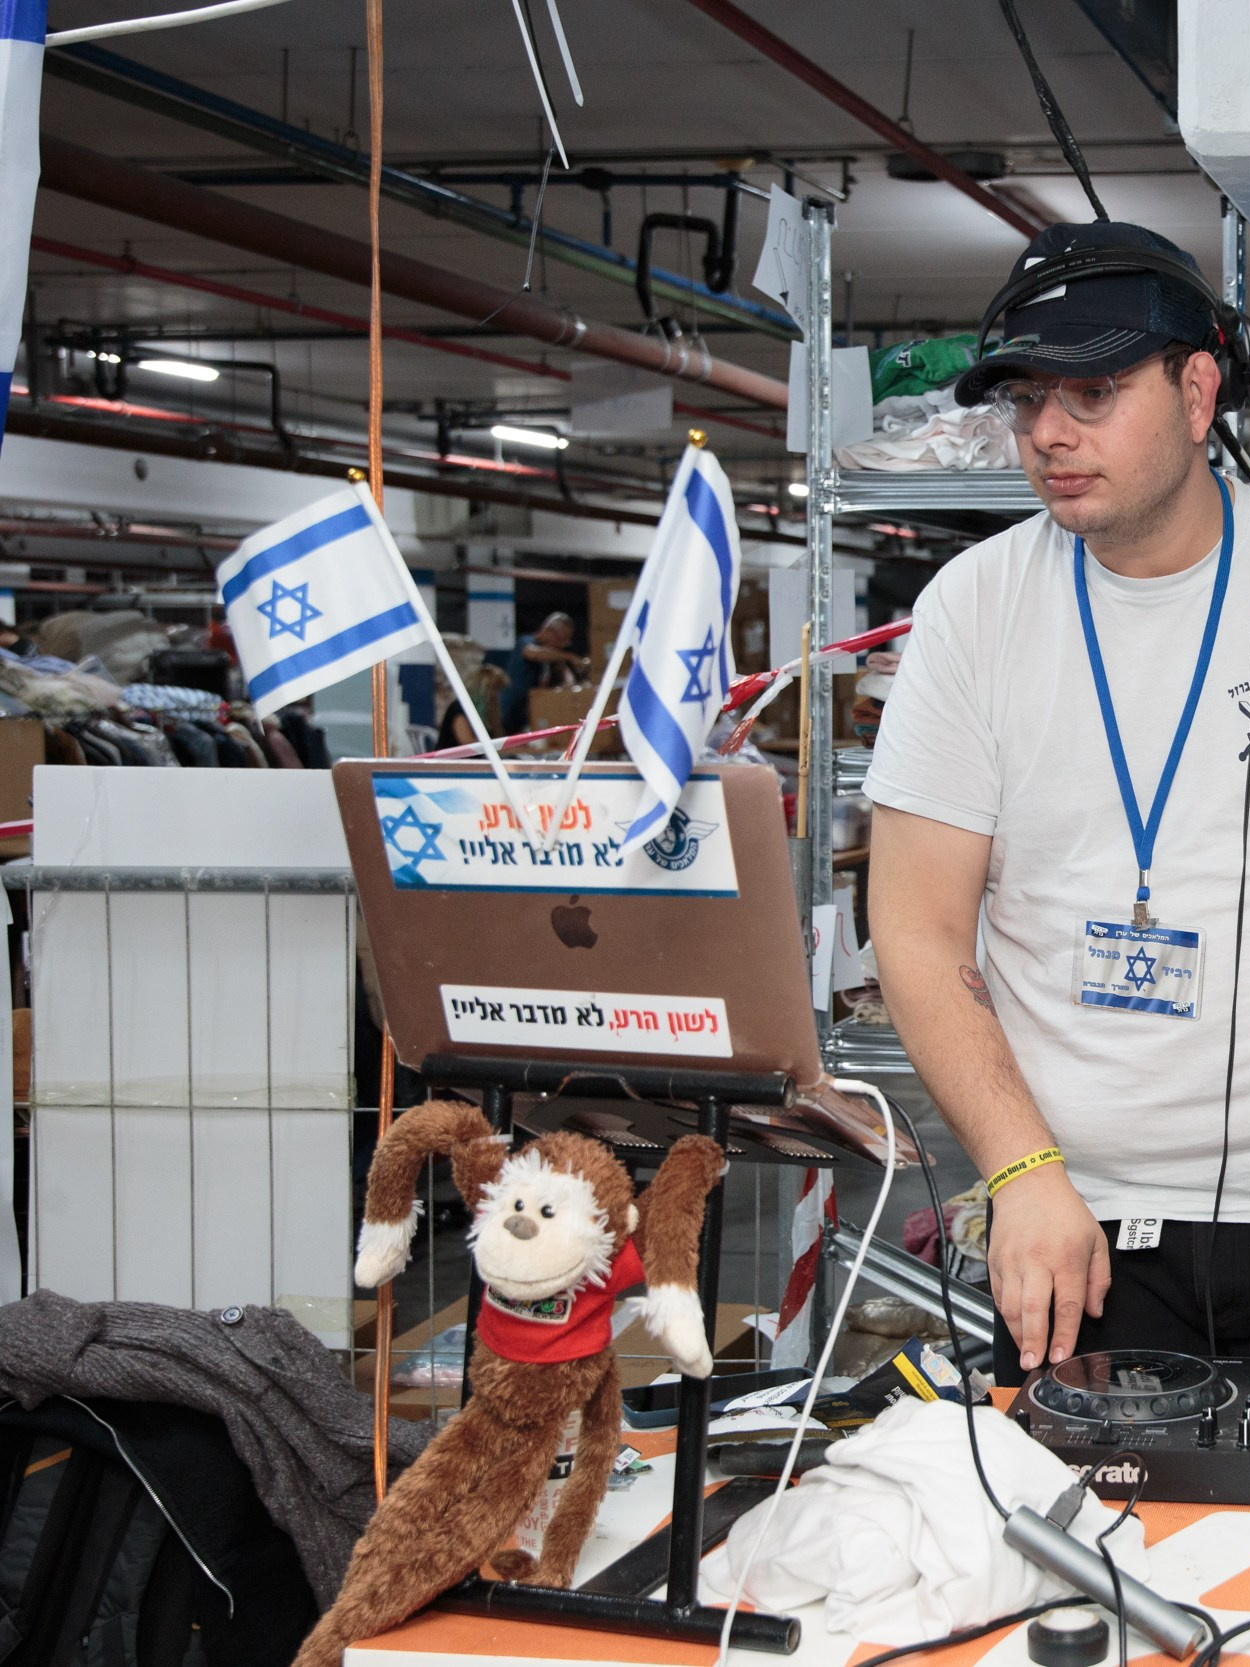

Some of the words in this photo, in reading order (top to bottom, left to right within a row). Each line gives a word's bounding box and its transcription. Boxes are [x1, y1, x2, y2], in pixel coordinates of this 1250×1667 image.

[1228, 681, 1250, 698] ברזל
[592, 836, 623, 867] לא
[1130, 930, 1140, 938] של
[1088, 945, 1121, 960] מנהל
[1162, 966, 1192, 979] רביד
[451, 997, 505, 1022] אליי!
[510, 1003, 568, 1026] מדבר
[576, 1002, 605, 1027] לא
[668, 1008, 719, 1040] לשון
[1006, 1161, 1027, 1176] Bring
[993, 1171, 1008, 1186] them
